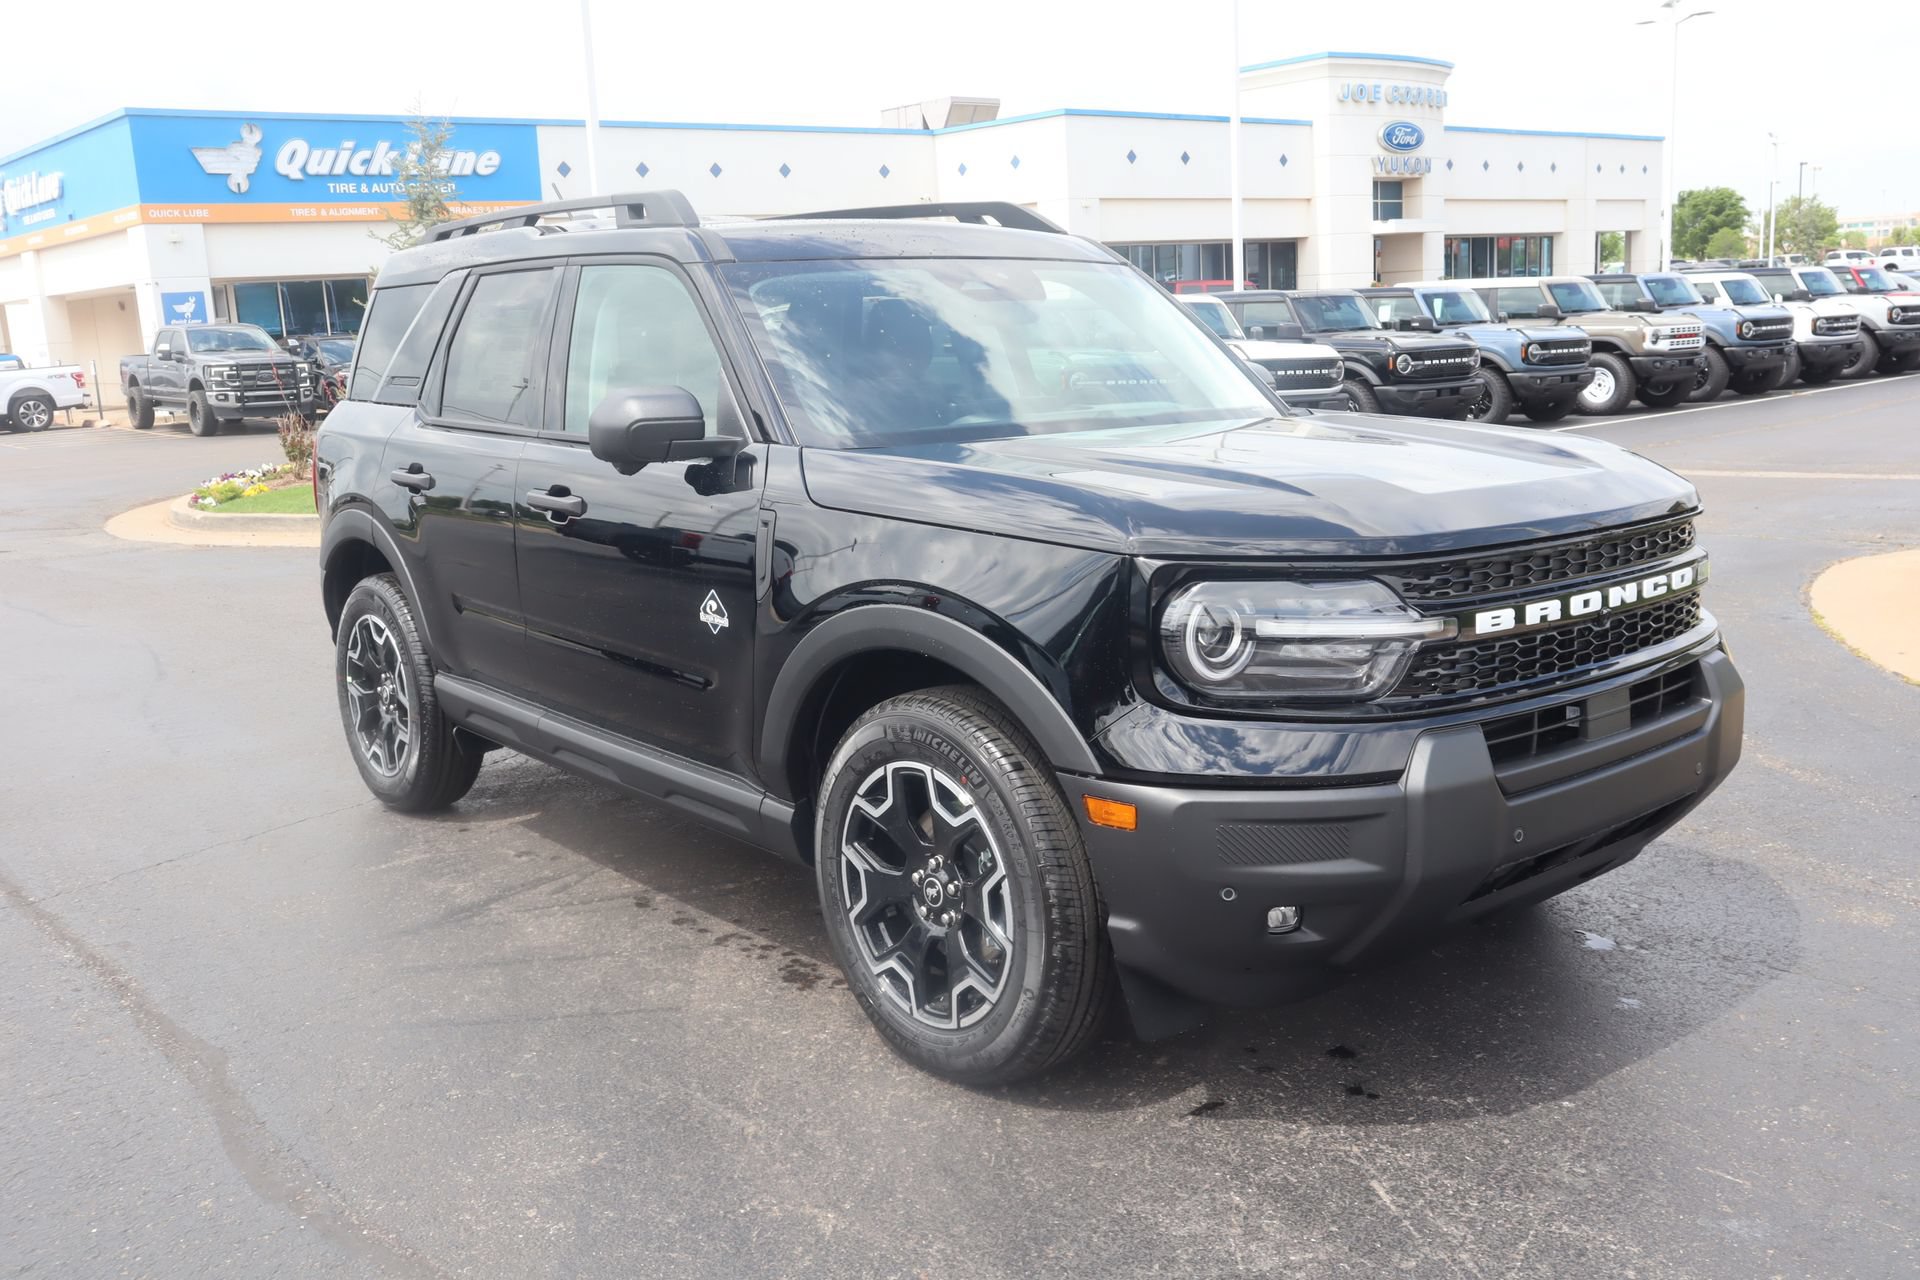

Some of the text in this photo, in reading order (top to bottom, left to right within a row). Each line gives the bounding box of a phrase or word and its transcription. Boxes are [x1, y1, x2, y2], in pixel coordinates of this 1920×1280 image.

[1340, 83, 1382, 102] JOE
[1392, 126, 1418, 145] Ford
[275, 137, 400, 180] Quick
[1377, 156, 1432, 173] YUKON
[327, 183, 456, 194] TIRE & AUTO CER
[148, 208, 181, 218] QUICK
[184, 208, 209, 217] LUBE
[290, 207, 380, 217] TIRES & ALIGNMENT
[1475, 567, 1693, 634] BRONCO
[912, 728, 983, 786] MICHELIN
